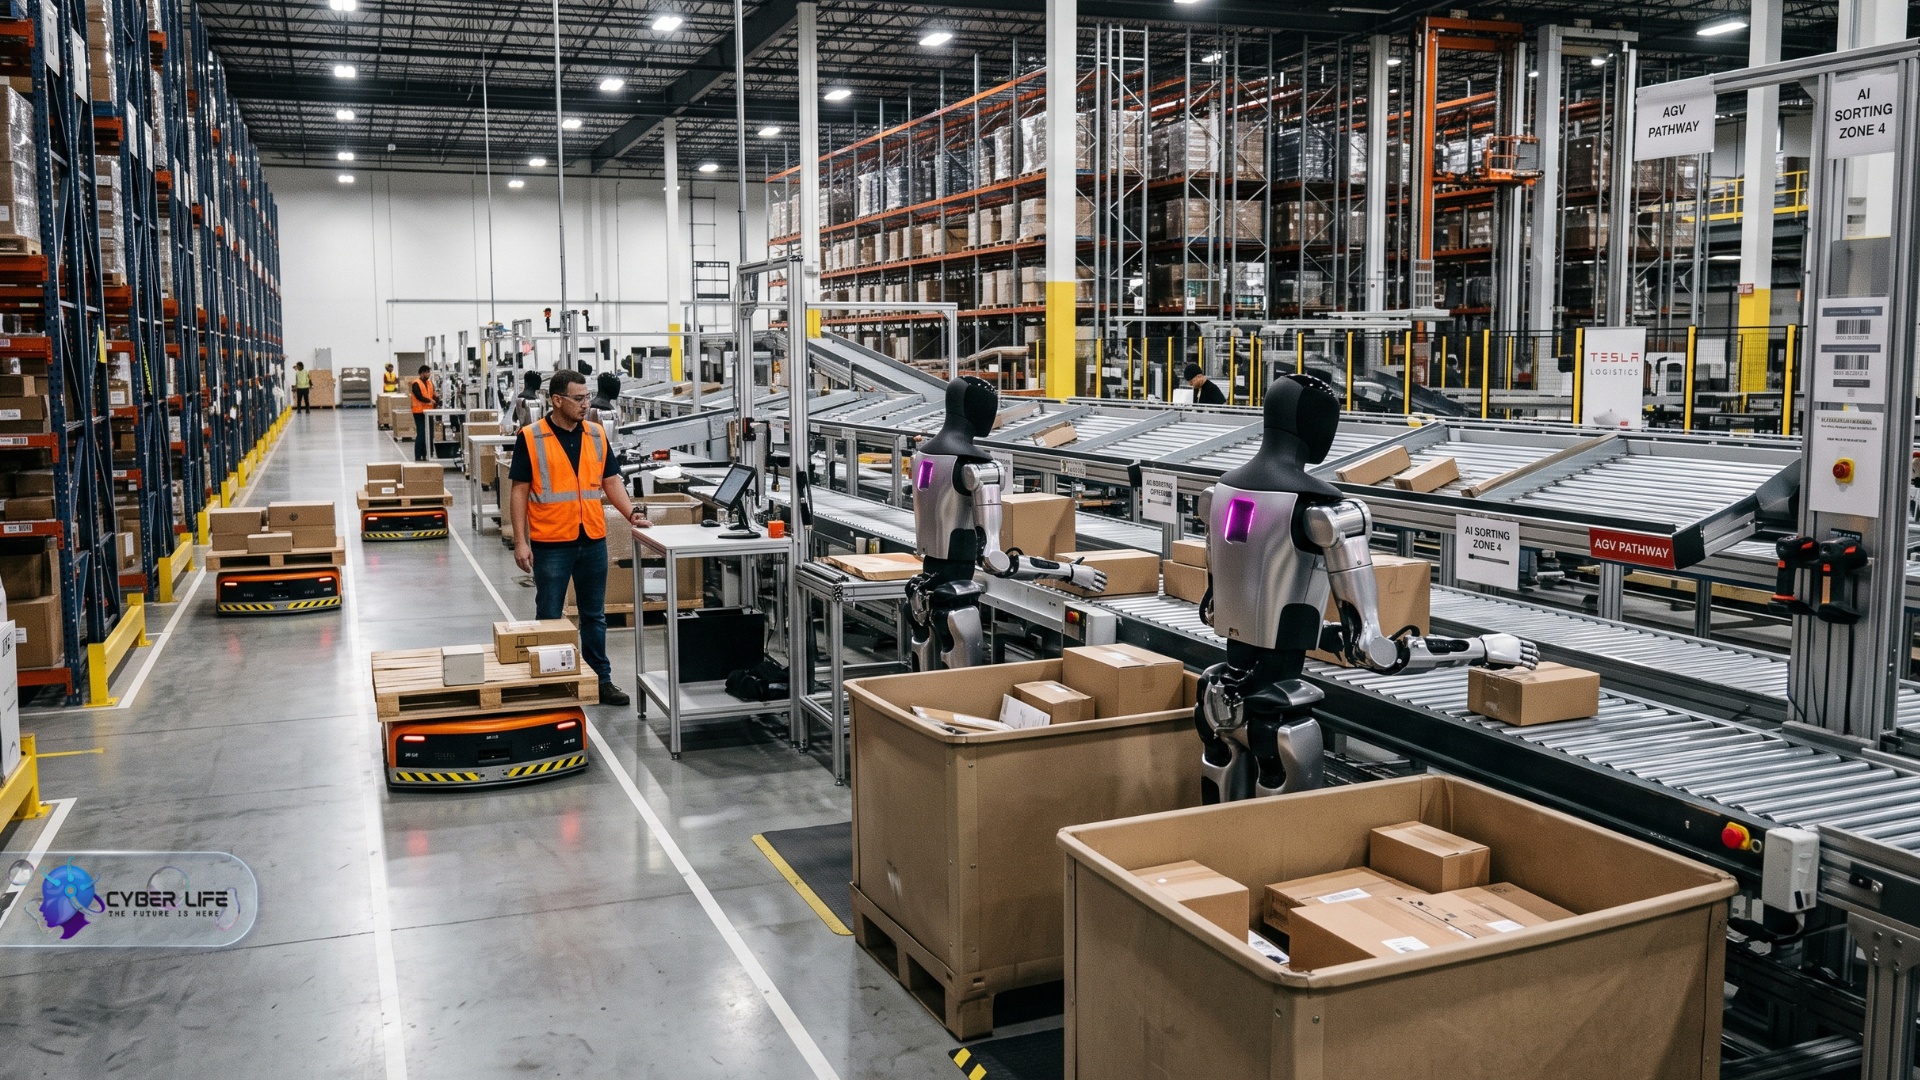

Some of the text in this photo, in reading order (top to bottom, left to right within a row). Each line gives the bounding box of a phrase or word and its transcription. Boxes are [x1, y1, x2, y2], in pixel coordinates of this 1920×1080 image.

[1857, 88, 1870, 100] AI
[1663, 104, 1686, 118] AGV
[1835, 103, 1893, 122] SORTING
[1648, 120, 1700, 138] PATHWAY
[1839, 122, 1886, 140] ZONE 4
[1590, 353, 1639, 362] TESLA
[1465, 525, 1510, 541] AI SORTING
[1473, 539, 1502, 552] ZONE 4
[1594, 538, 1670, 559] AGV PATHWAY
